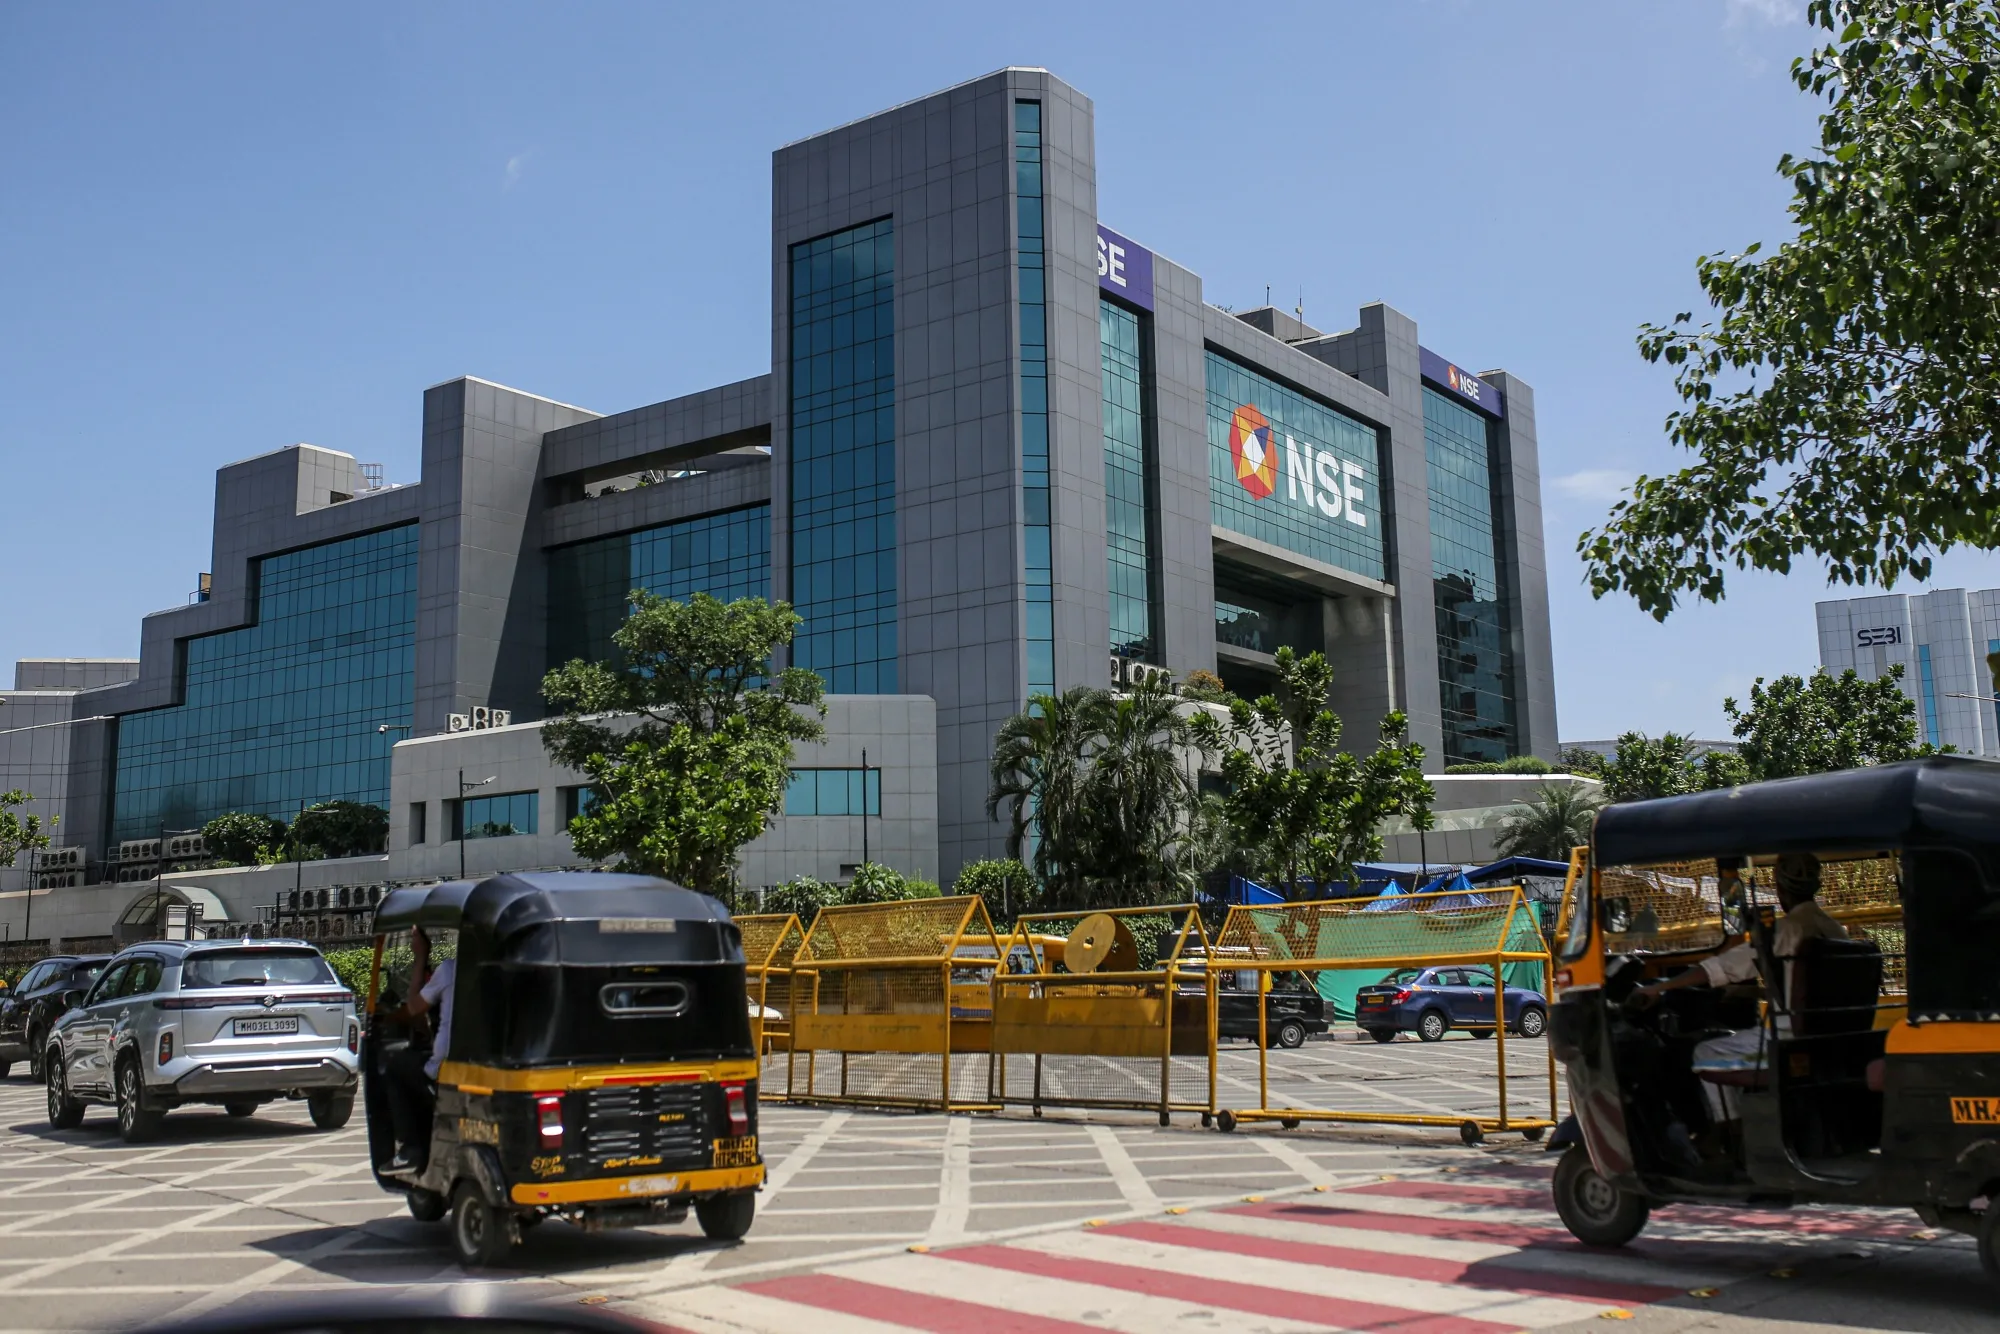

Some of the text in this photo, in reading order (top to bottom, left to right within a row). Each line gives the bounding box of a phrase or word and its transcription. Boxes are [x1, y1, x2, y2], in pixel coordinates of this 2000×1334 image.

[1460, 373, 1480, 401] NSE
[1286, 434, 1367, 528] NSE
[1857, 626, 1902, 648] SEBI
[241, 1020, 296, 1032] MH03EL3099
